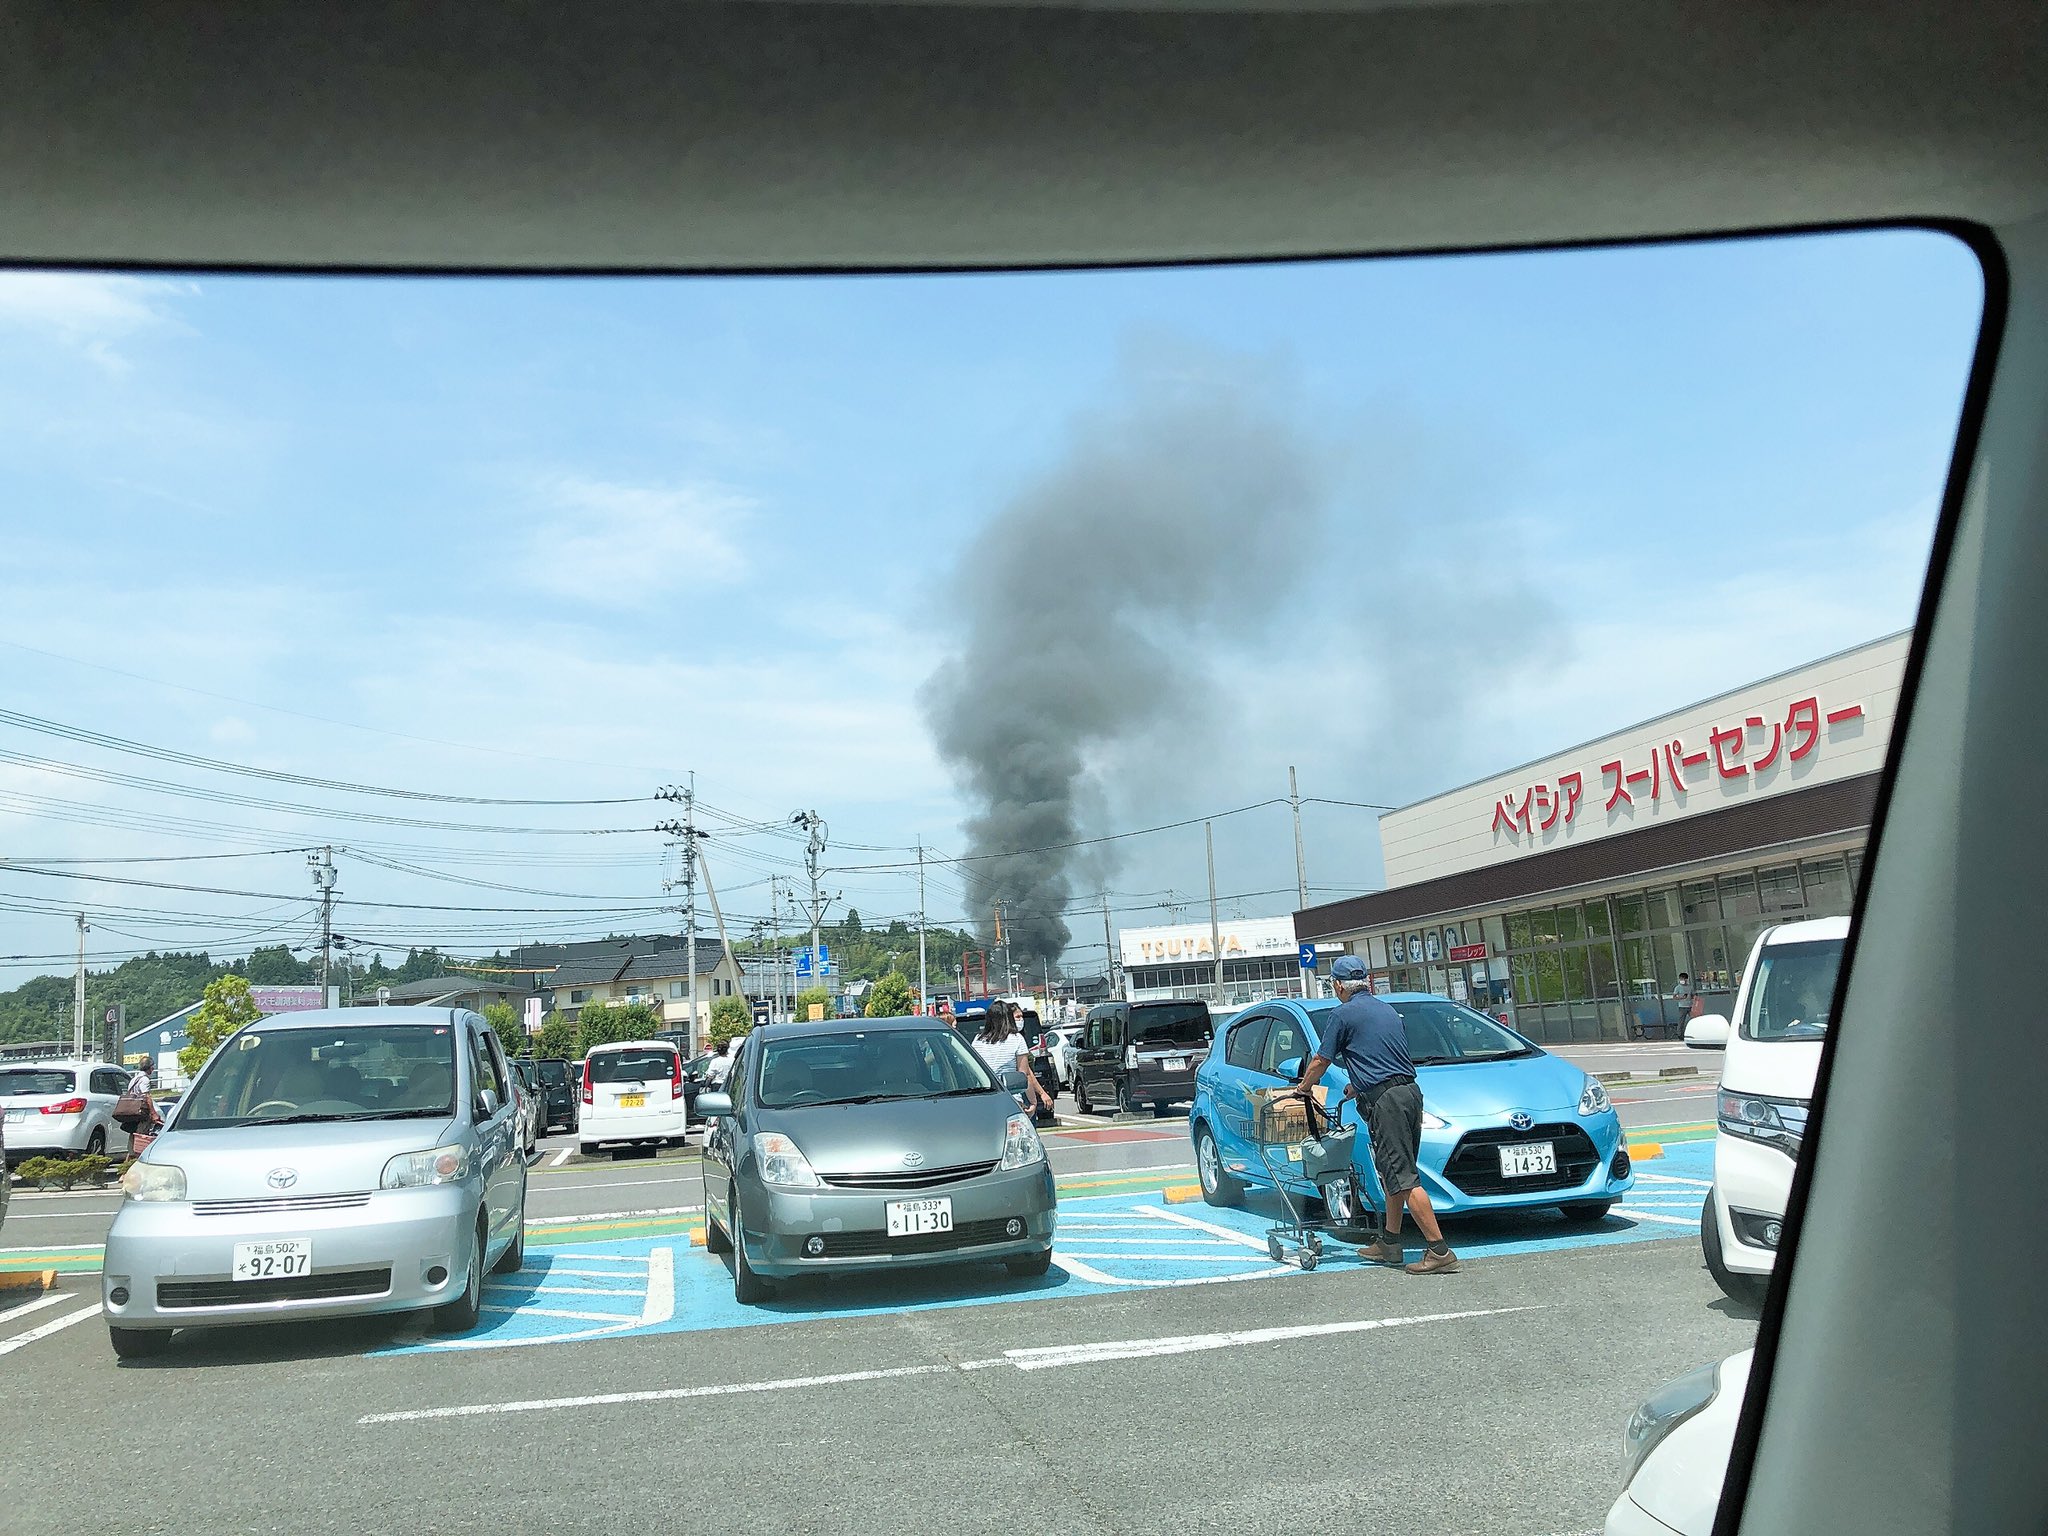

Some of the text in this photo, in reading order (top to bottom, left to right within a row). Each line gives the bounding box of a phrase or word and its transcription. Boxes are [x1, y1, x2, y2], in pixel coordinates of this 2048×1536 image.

[1492, 696, 1863, 834] ベイシア スーパーセンター
[1141, 935, 1243, 956] TSUTAYA
[1514, 1155, 1553, 1173] 14-32
[904, 1211, 949, 1232] 11-30
[250, 1254, 307, 1277] 92-07
